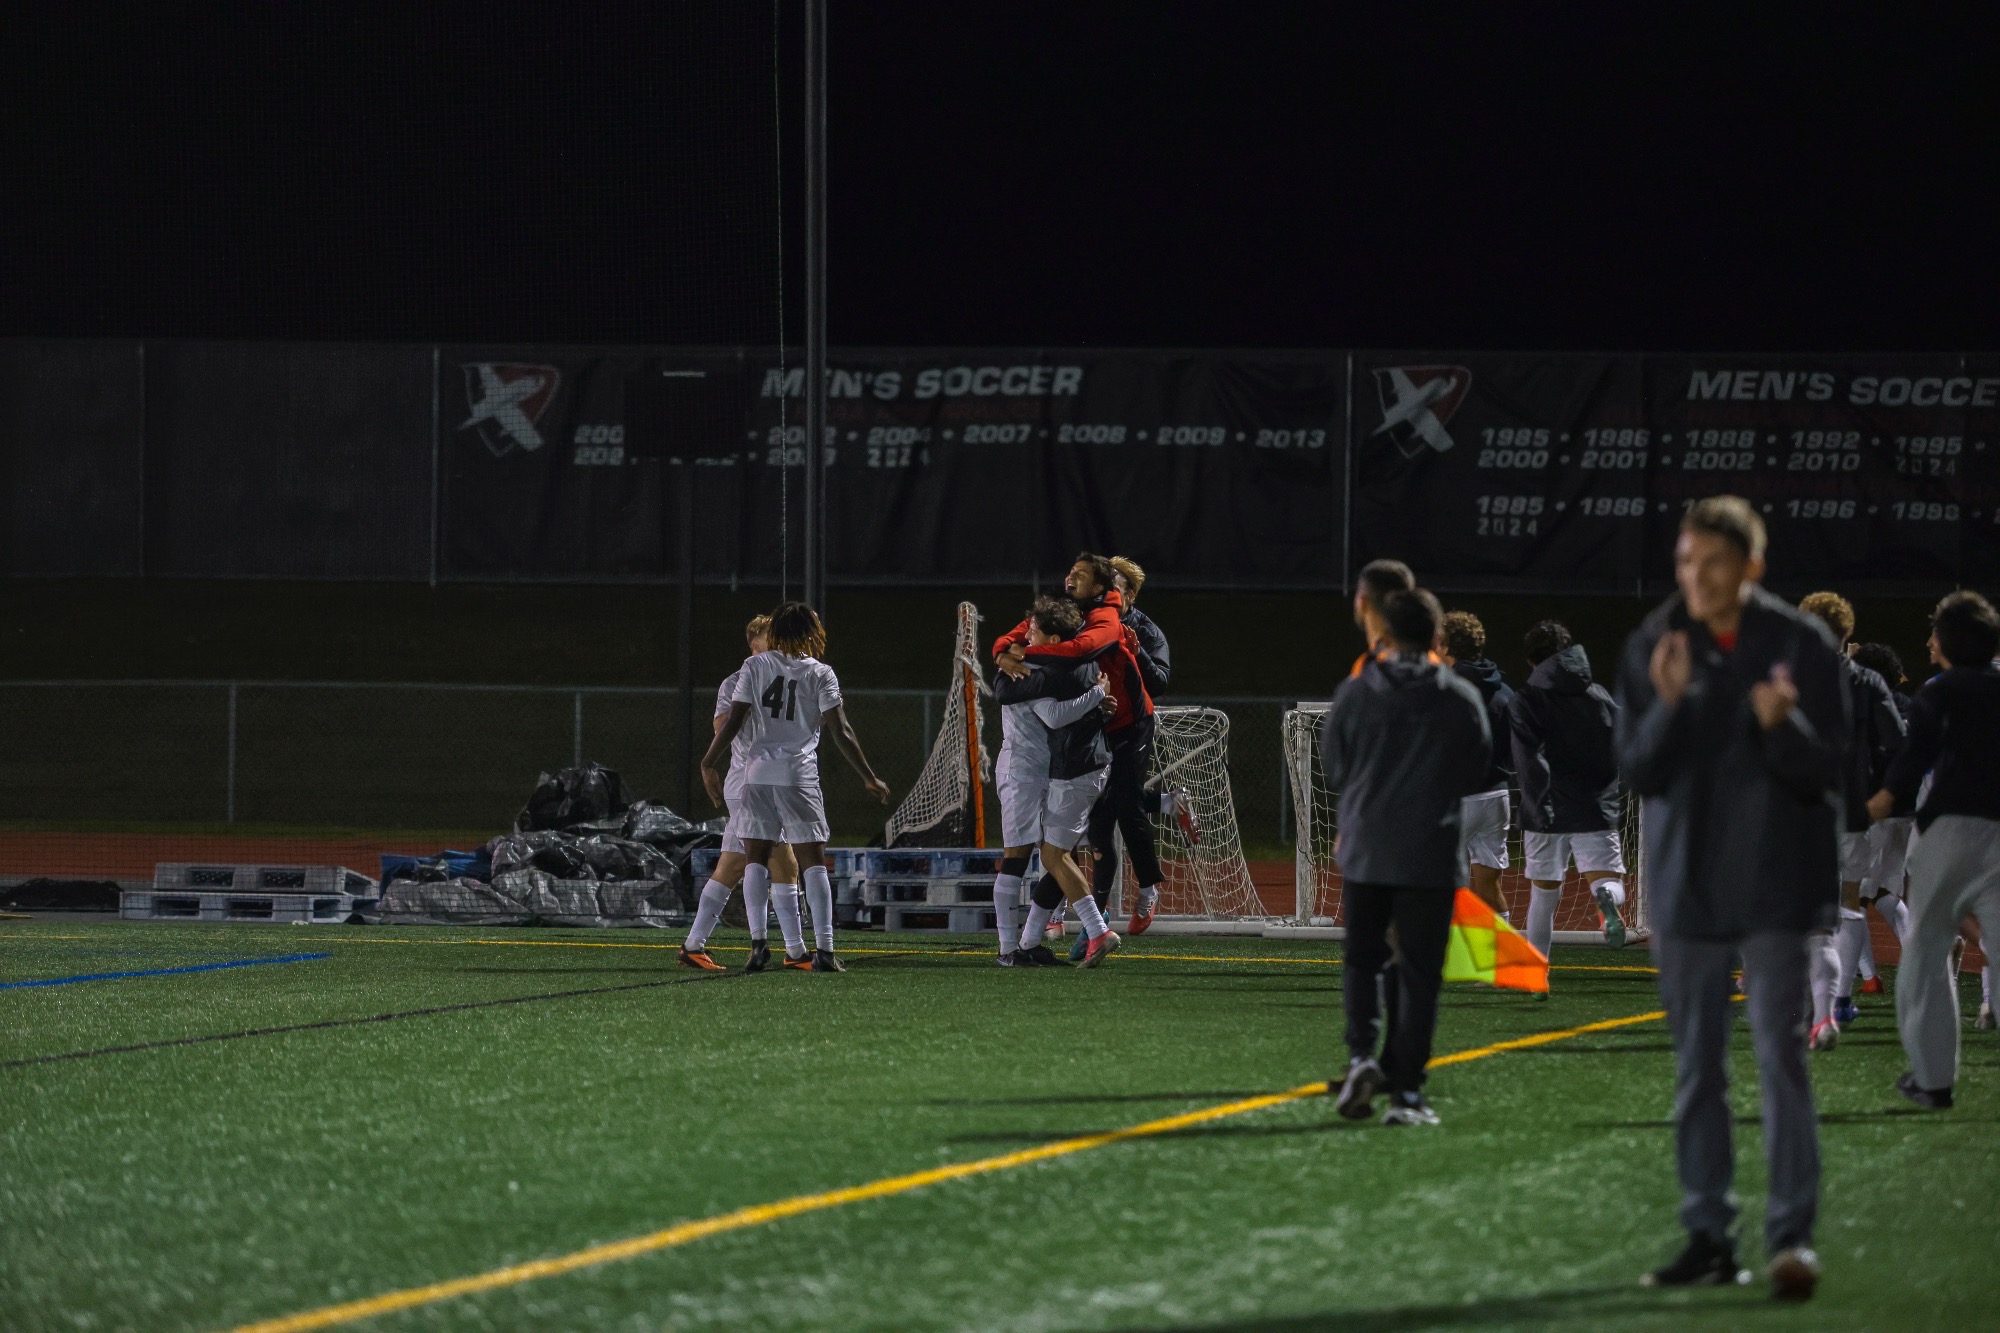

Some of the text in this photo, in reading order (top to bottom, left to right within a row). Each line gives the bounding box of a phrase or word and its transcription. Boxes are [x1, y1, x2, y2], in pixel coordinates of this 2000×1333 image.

[761, 365, 1084, 400] MN'S SOCCER
[1686, 370, 1835, 401] MEN'S
[963, 424, 1032, 444] 2007
[1057, 424, 1127, 444] 2008
[1156, 426, 1226, 446] 2009
[1255, 429, 1326, 449] 2013
[1481, 428, 1963, 455] 1985 1986 1988 1992 1995
[1477, 449, 1549, 469] 2000
[1580, 450, 1649, 470] 2001
[1682, 452, 1755, 471] 2002
[1786, 453, 1861, 472] 2010
[1476, 496, 1545, 516] 1985
[1580, 497, 1647, 517] 1986
[1786, 500, 1857, 519] 1996
[1477, 517, 1538, 536] 2024
[762, 675, 797, 721] 41
